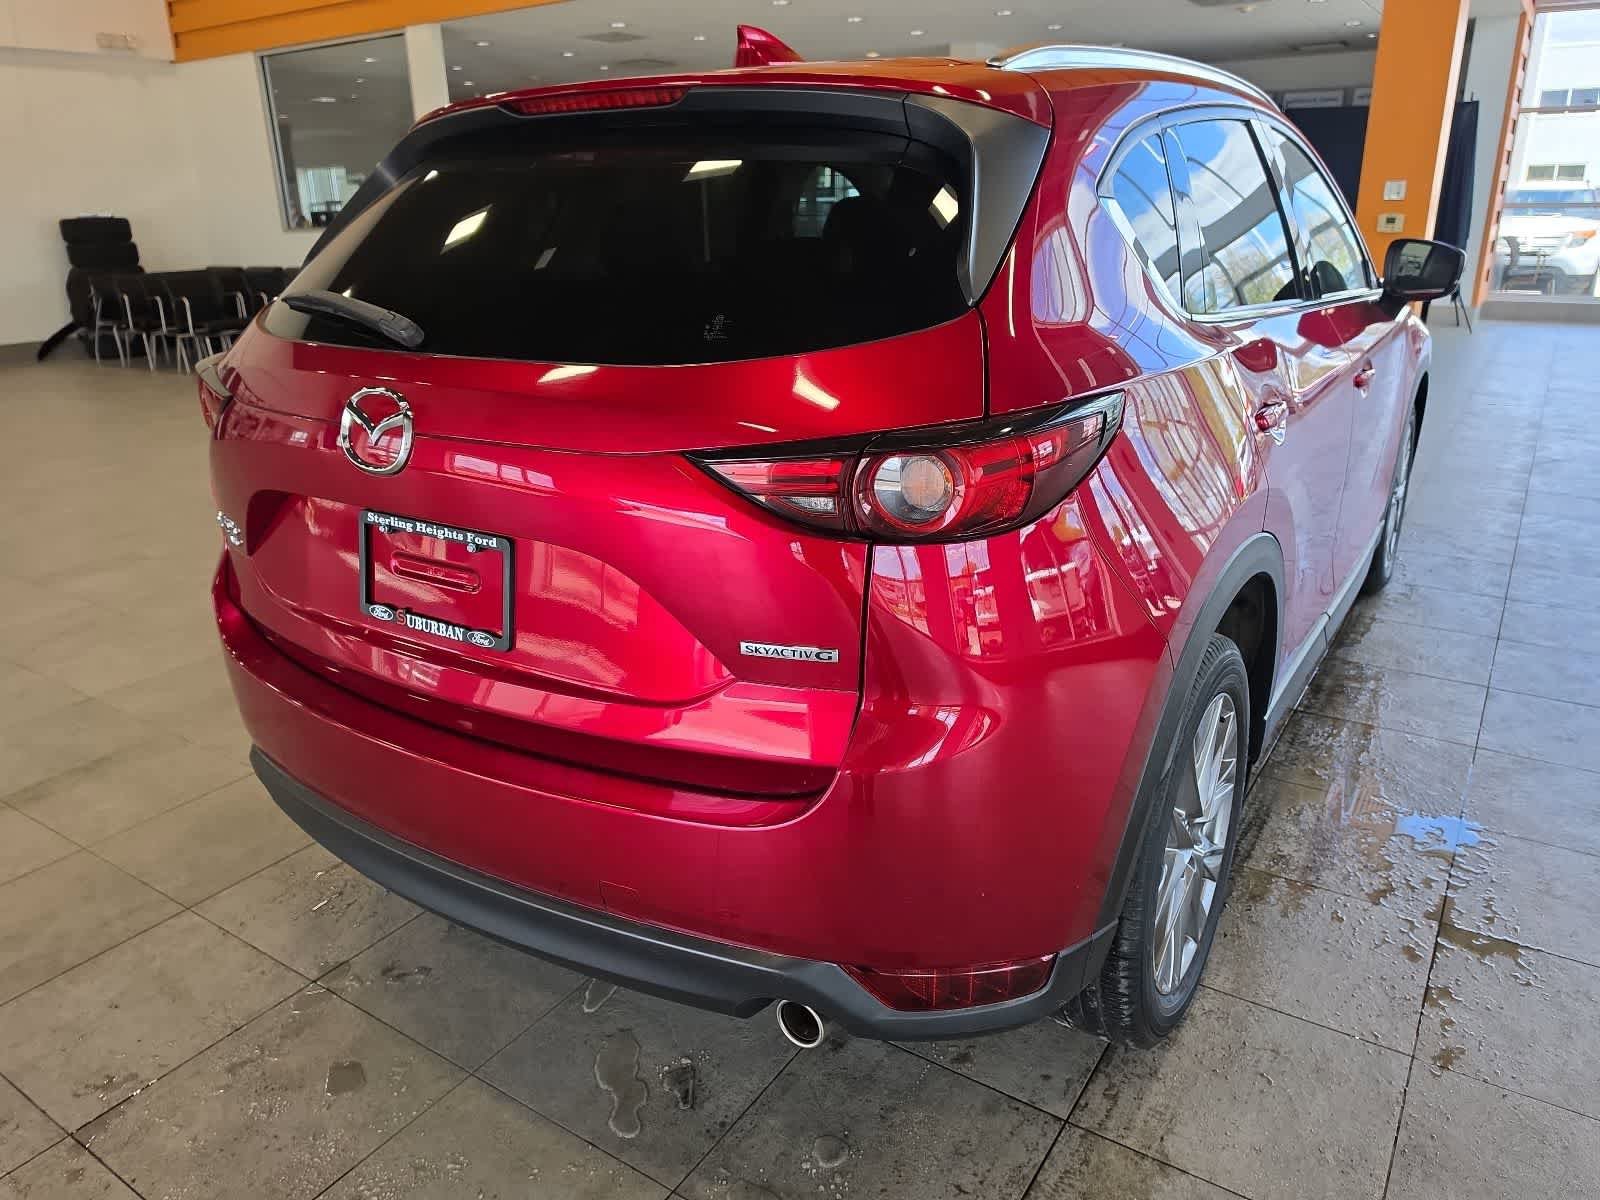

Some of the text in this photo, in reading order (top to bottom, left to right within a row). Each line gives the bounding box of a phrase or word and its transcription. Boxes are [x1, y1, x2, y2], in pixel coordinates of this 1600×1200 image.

[367, 512, 497, 548] Sterling Heights Ford
[396, 609, 464, 641] SUBURBAN
